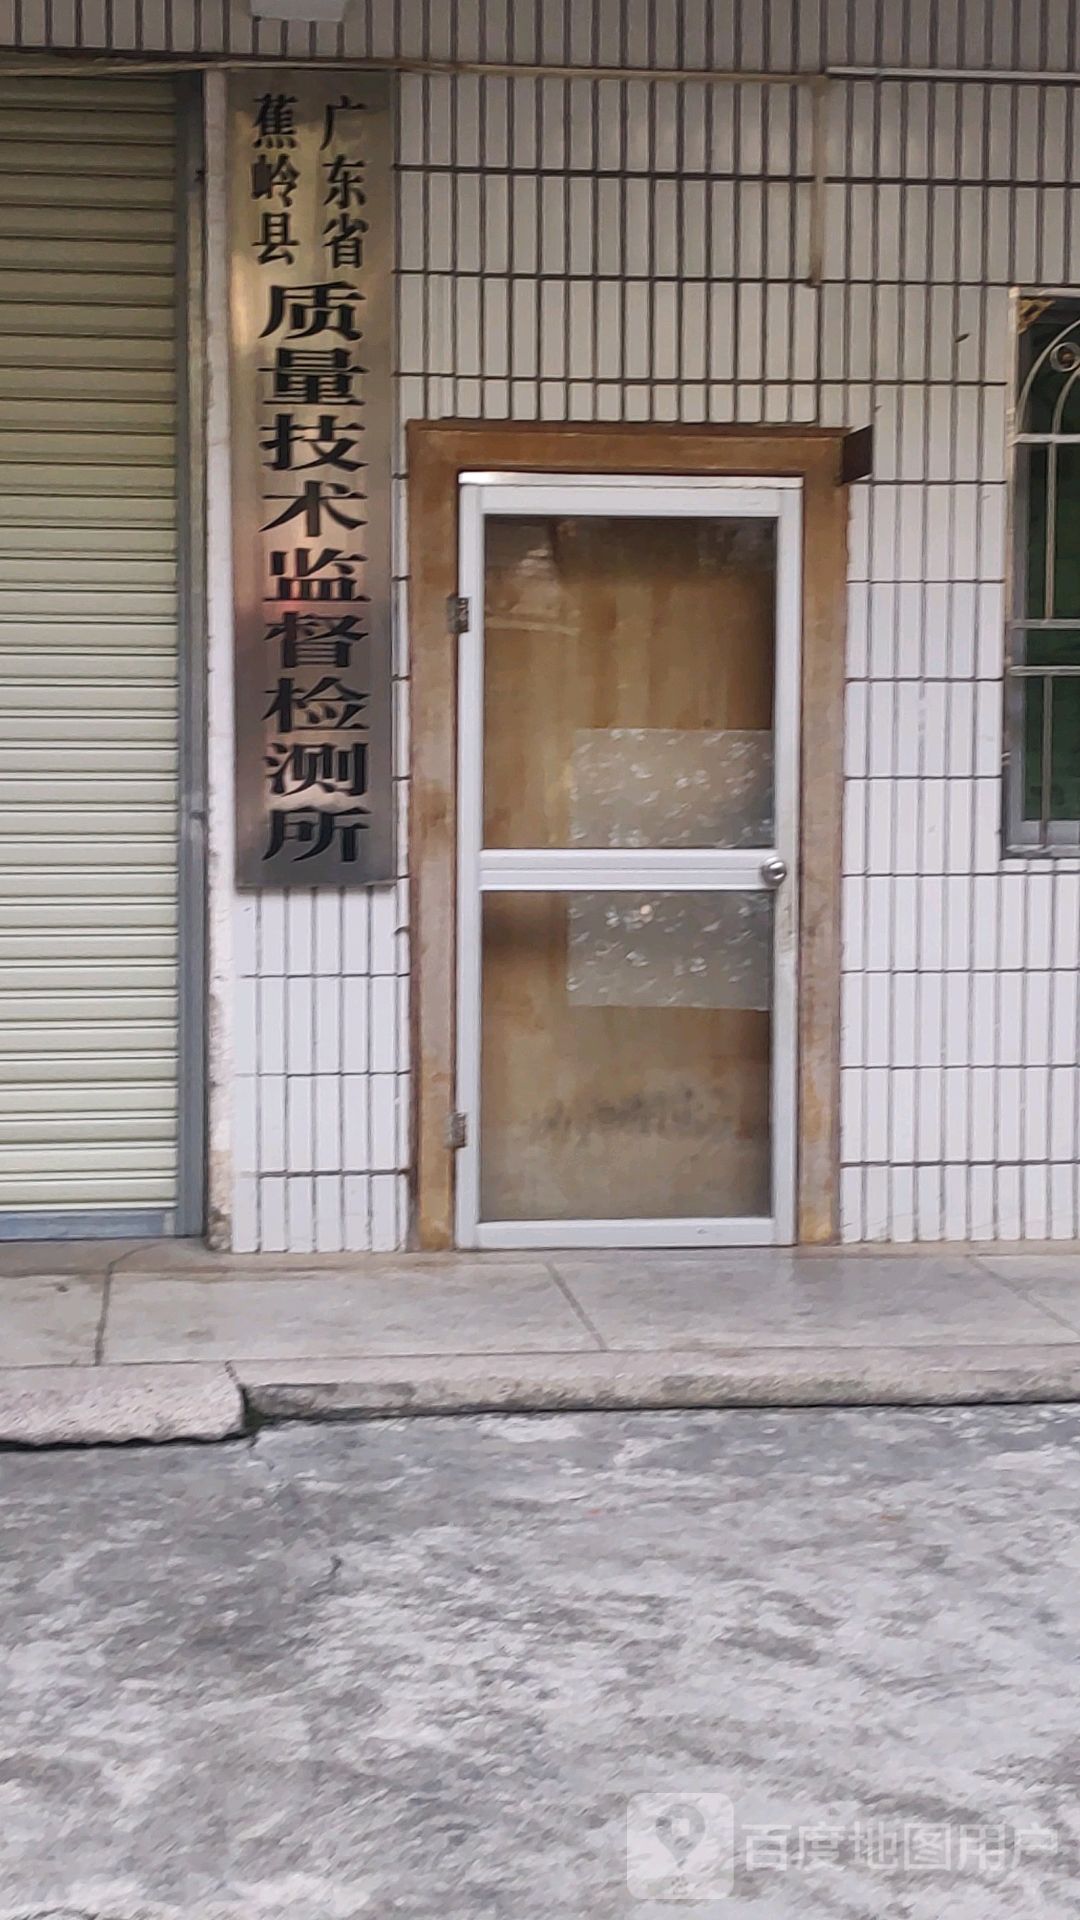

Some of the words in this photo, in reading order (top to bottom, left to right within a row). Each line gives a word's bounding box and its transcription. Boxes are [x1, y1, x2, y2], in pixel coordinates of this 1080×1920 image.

[250, 93, 300, 265] 蕉岭县
[320, 95, 368, 268] 广东省
[258, 280, 372, 863] 质量技术监督检测所
